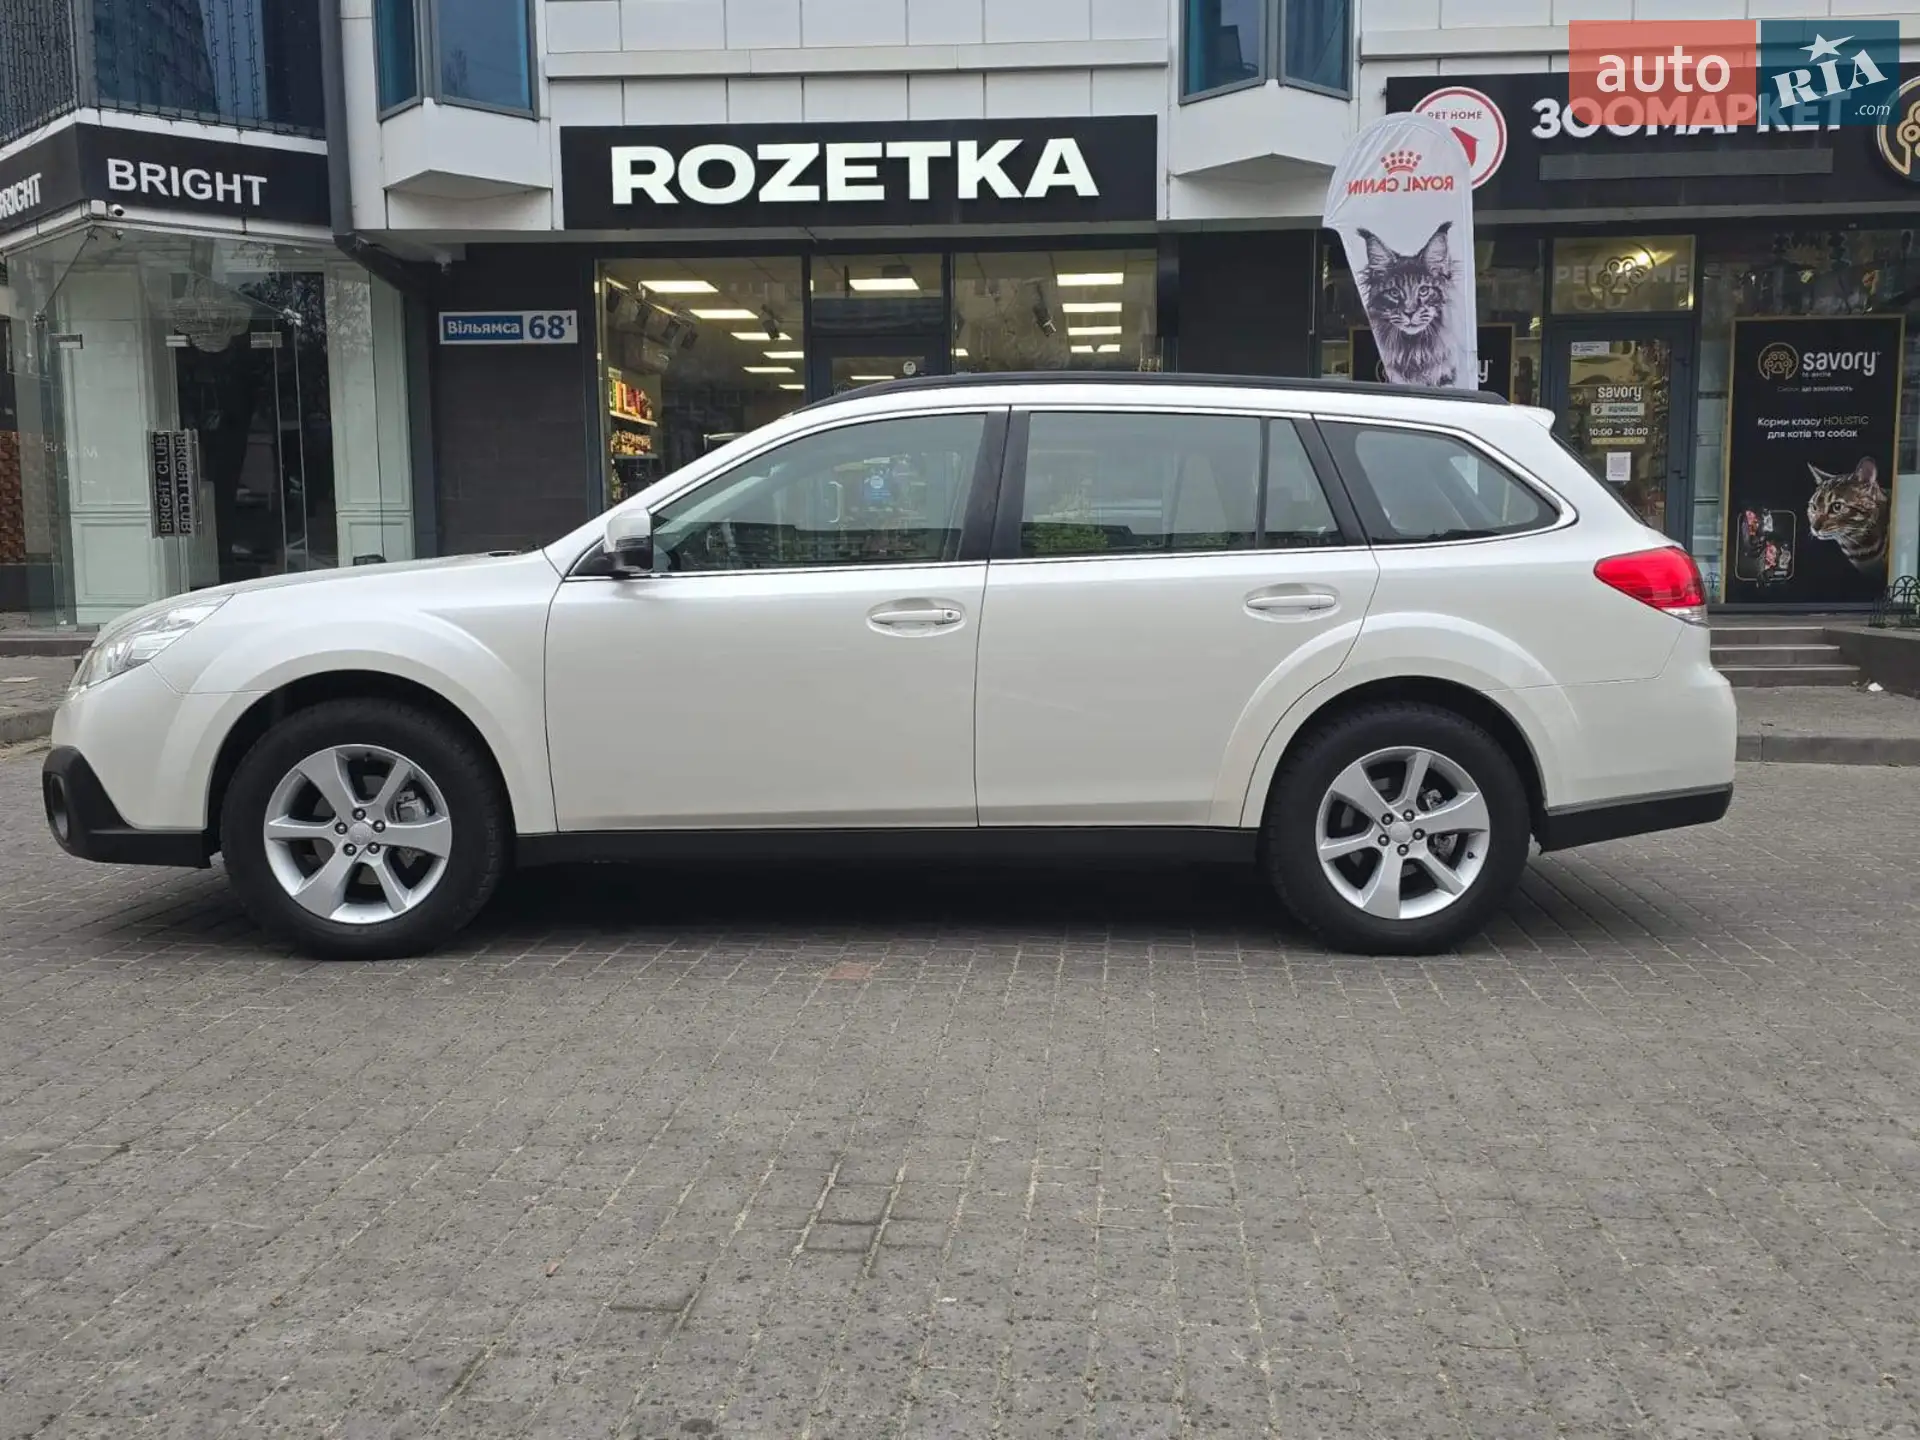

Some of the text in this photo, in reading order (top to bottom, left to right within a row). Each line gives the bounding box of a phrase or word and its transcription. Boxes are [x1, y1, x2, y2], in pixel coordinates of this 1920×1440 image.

[1450, 111, 1483, 120] HOME
[1531, 91, 1852, 139] ЗООМАРКЕТ
[611, 137, 1100, 205] ROZETKA
[107, 158, 268, 206] BRIGHT
[446, 320, 520, 335] Вільямса
[1803, 351, 1876, 376] savory
[1597, 386, 1643, 401] savory
[1589, 428, 1613, 436] 10:00
[1623, 427, 1649, 436] 20:00
[1757, 417, 1790, 427] Корми
[1791, 416, 1821, 427] класу
[1767, 428, 1858, 440] для котів та собак
[155, 434, 173, 533] BRIGHT CLUB
[178, 491, 192, 533] CLUB
